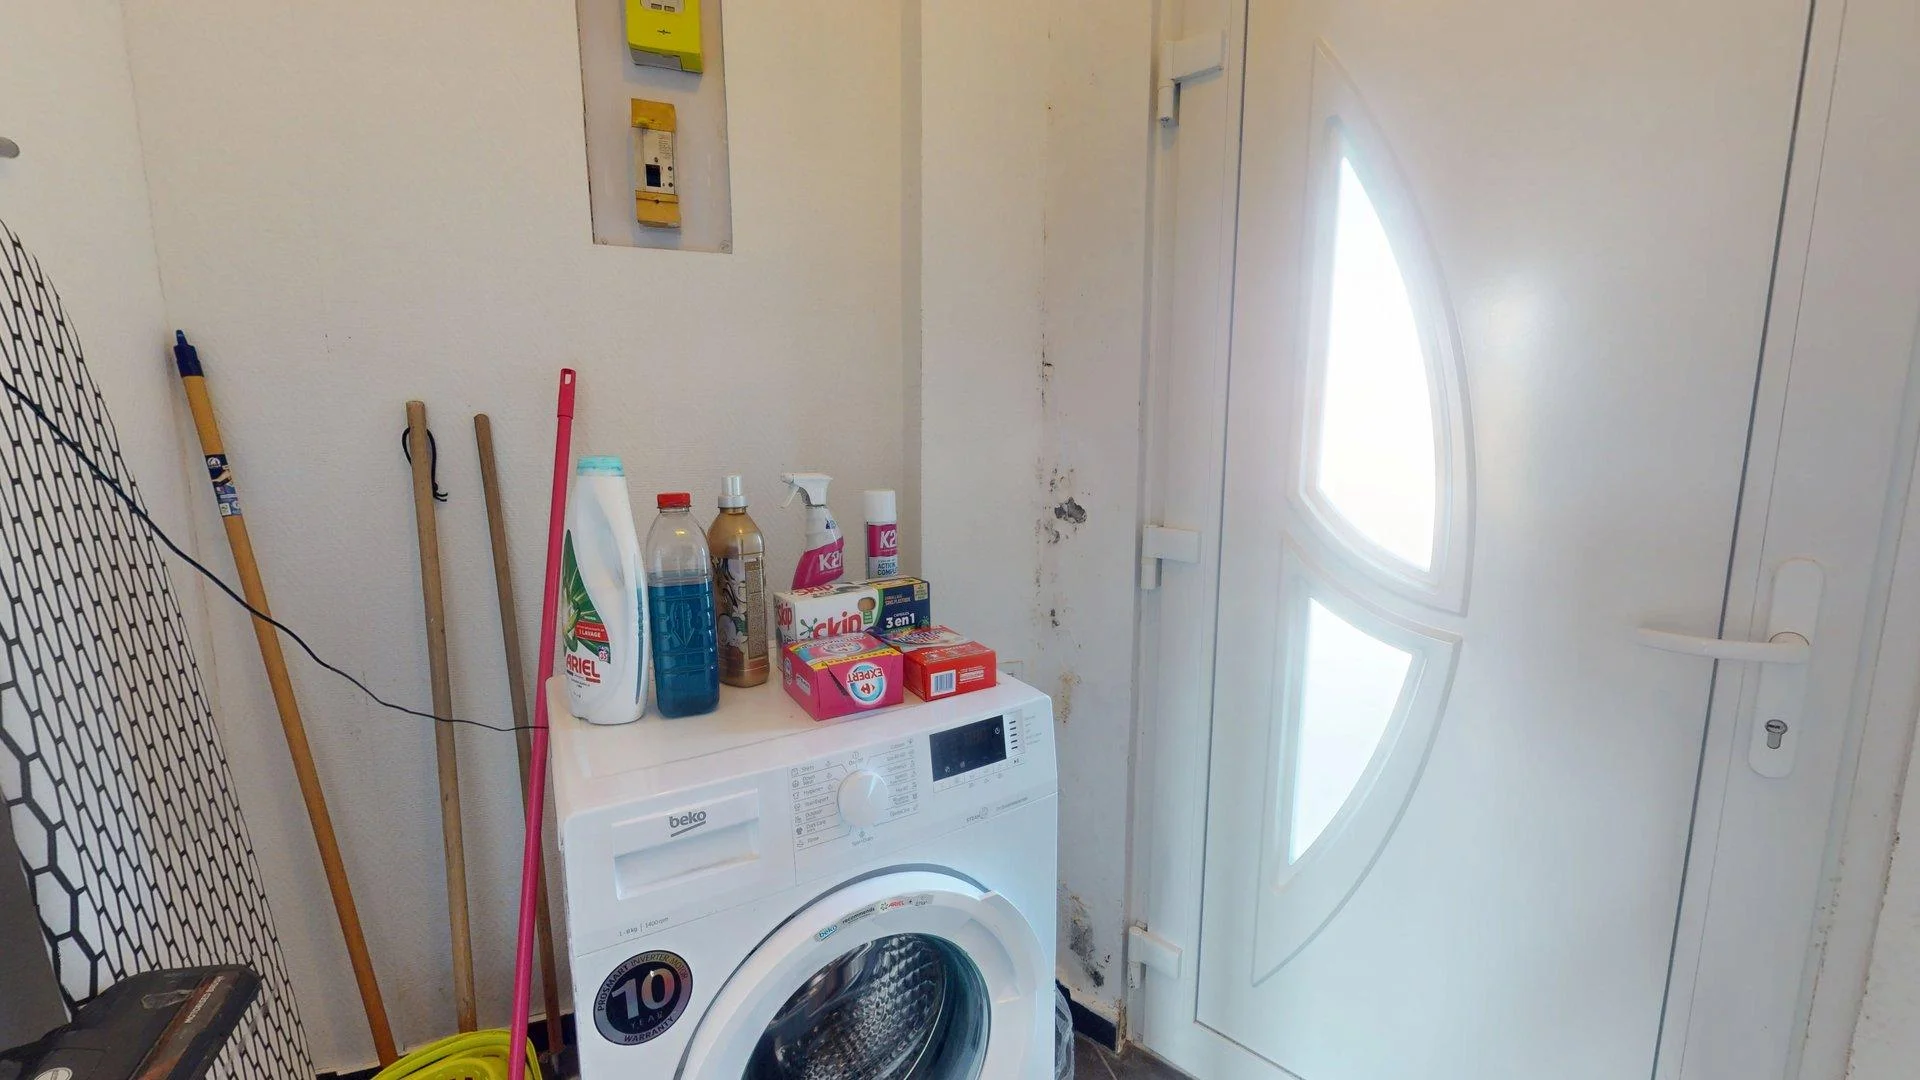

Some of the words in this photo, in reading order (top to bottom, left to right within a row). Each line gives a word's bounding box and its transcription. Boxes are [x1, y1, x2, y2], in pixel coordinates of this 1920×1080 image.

[880, 530, 896, 548] K2
[885, 616, 894, 629] 3
[894, 615, 909, 627] en
[909, 613, 916, 624] 1
[582, 629, 601, 637] LAVAGE
[566, 653, 601, 678] ARIEL
[846, 667, 884, 683] EXPERT
[669, 810, 707, 829] beko
[842, 907, 875, 924] recommends
[597, 964, 630, 1012] PROSMART
[631, 953, 669, 967] INVERTER
[611, 967, 676, 1020] 10
[624, 1015, 676, 1042] WARRANTY
[631, 1010, 664, 1030] YEAR
